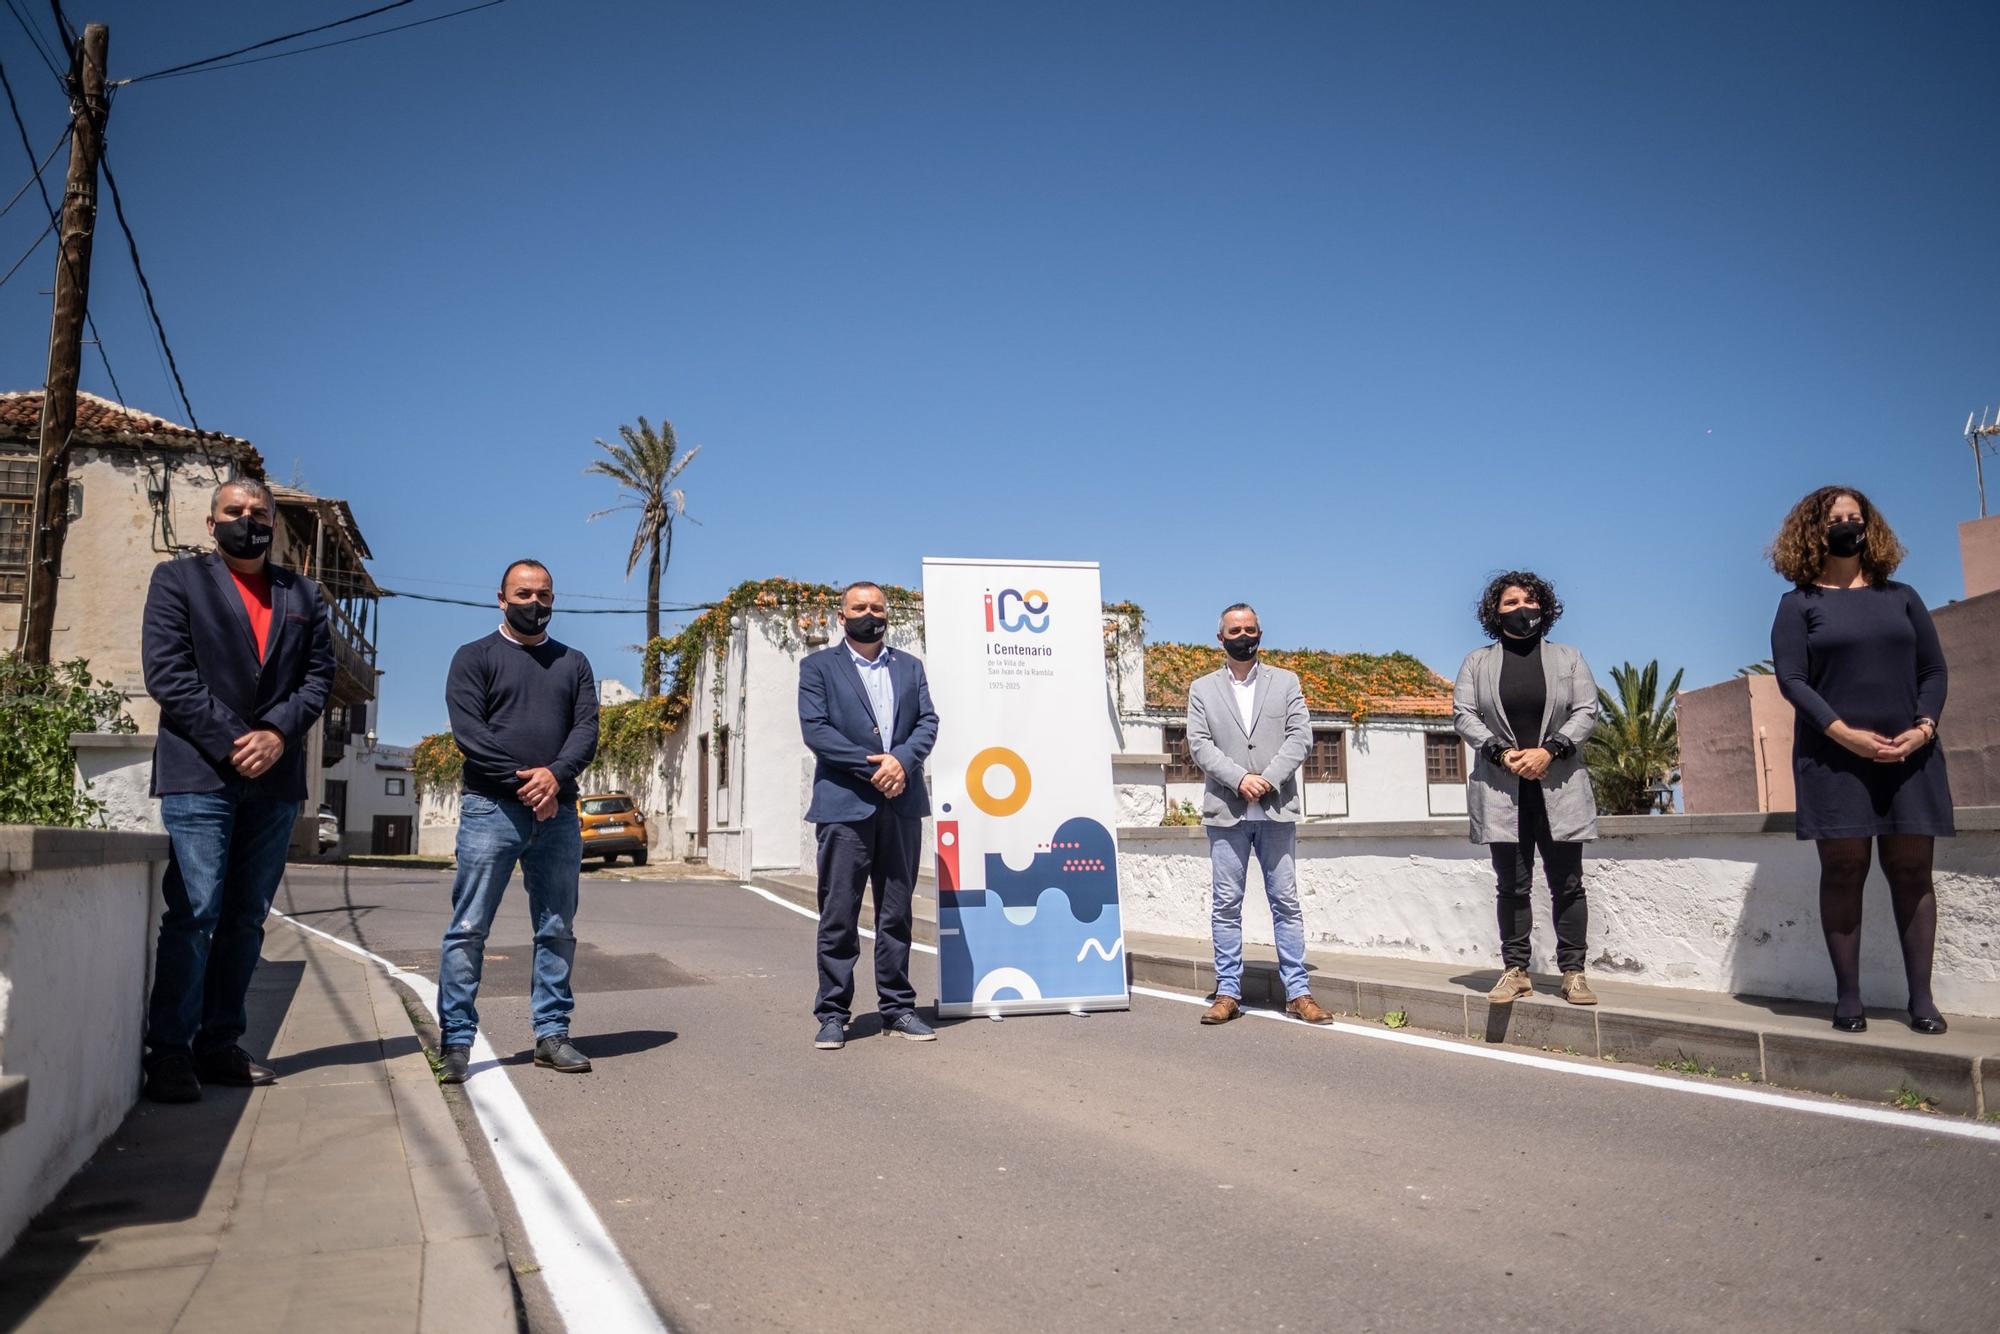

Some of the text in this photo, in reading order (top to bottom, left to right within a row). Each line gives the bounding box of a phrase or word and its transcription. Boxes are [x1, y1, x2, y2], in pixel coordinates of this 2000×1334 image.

[994, 643, 1052, 656] Centenario
[987, 667, 1000, 675] San
[1031, 668, 1054, 676] Rambla
